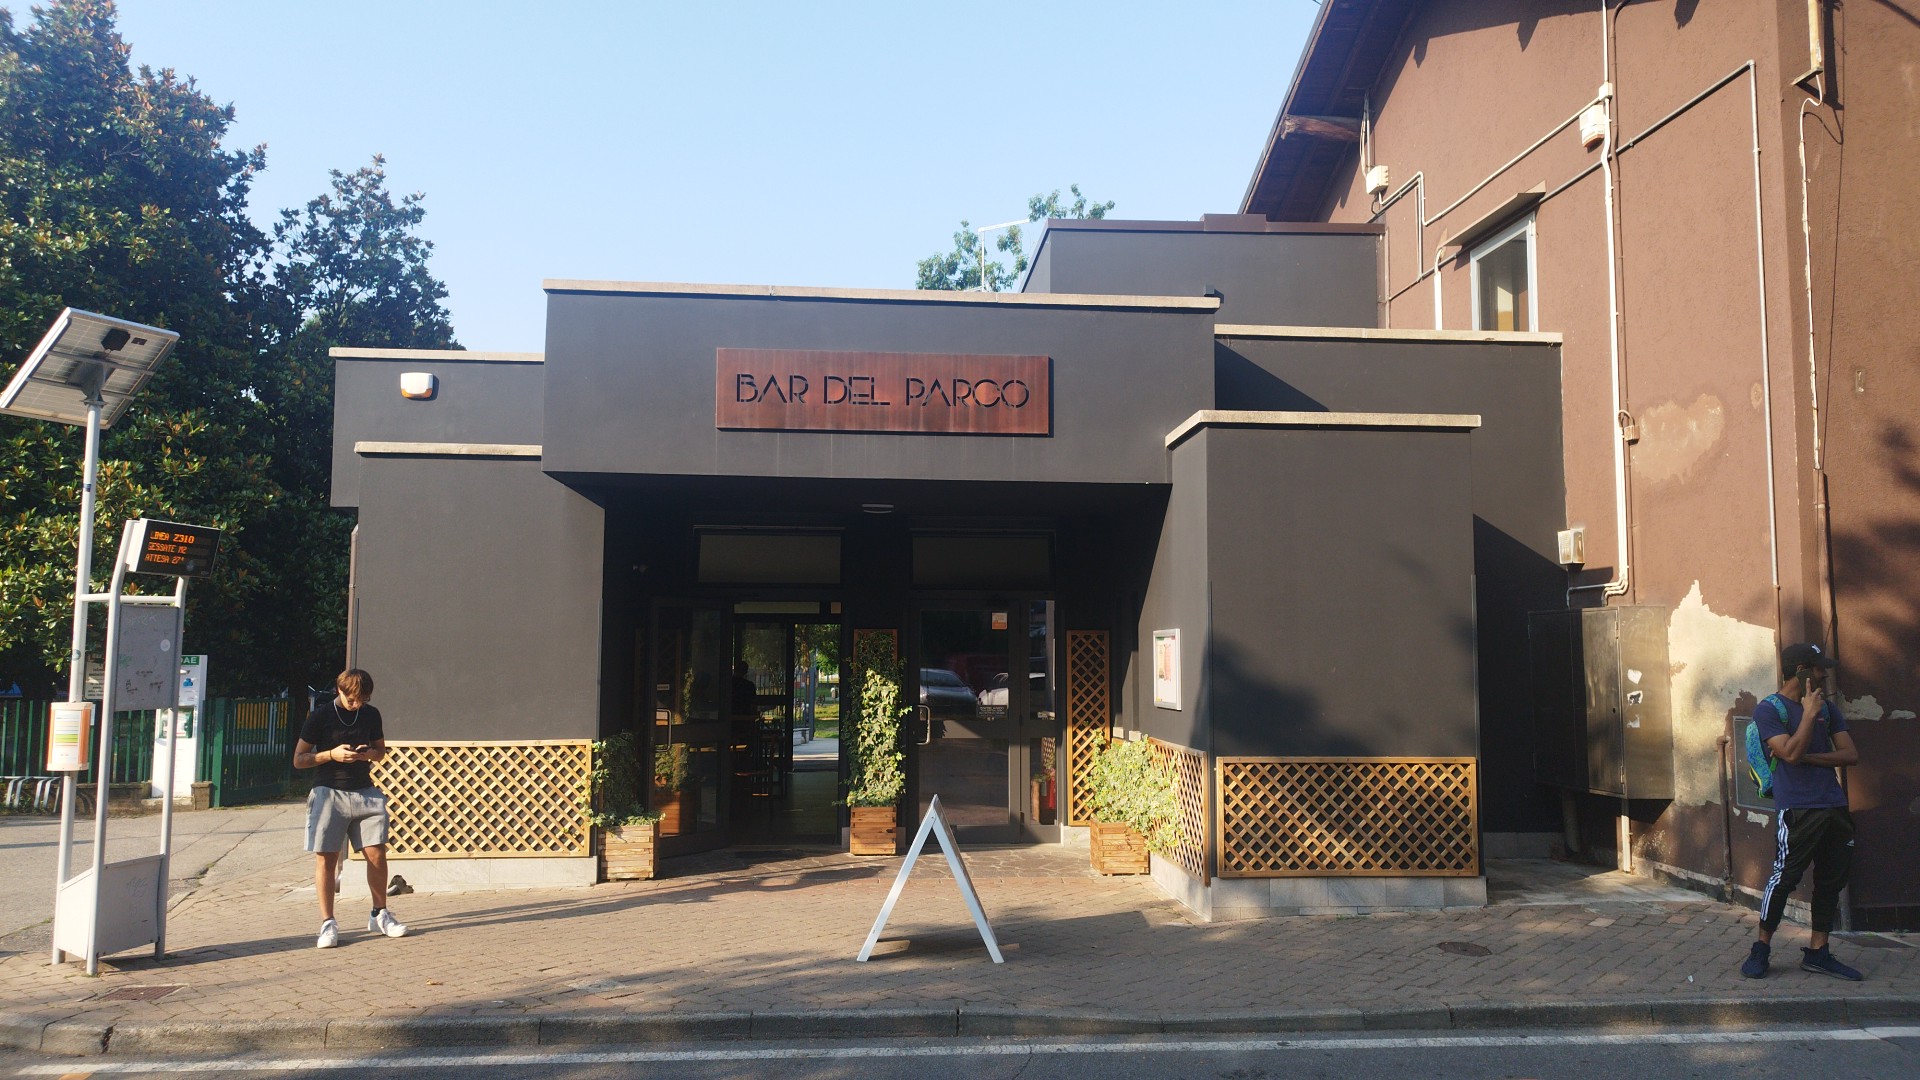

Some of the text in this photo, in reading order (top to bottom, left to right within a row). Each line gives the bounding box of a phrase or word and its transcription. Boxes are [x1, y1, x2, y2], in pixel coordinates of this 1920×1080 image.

[736, 373, 1030, 408] BAR DEL PARCO
[144, 553, 170, 563] ATTESA
